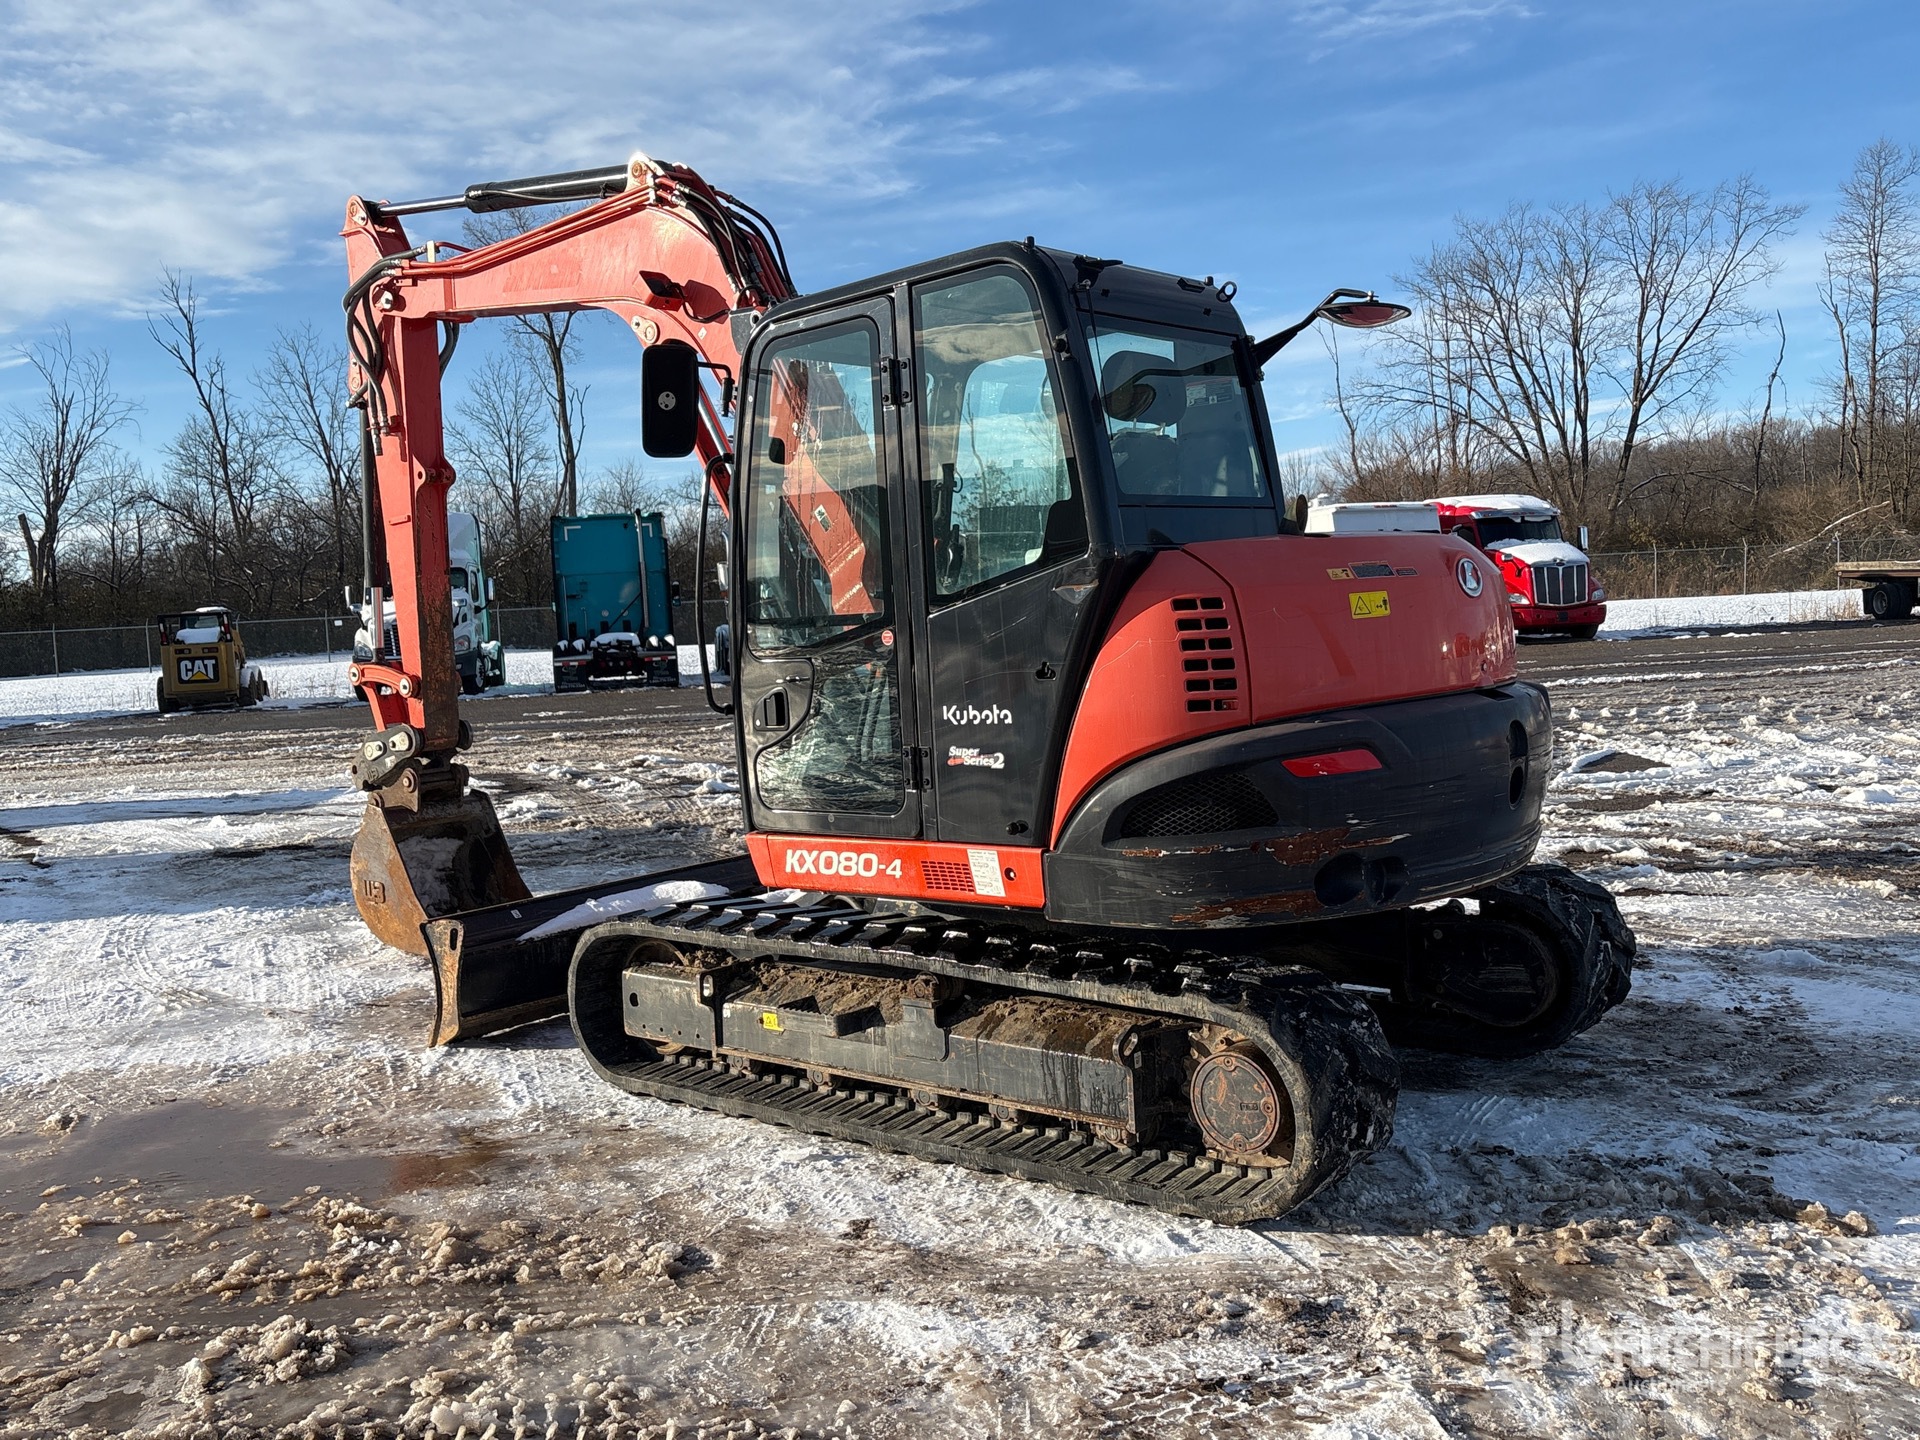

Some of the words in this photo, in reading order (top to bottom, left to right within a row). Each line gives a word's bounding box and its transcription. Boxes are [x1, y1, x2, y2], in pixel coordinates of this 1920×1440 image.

[180, 659, 216, 681] CAT
[942, 704, 1013, 725] Kubota
[948, 745, 981, 759] Super
[785, 848, 903, 879] KX080-4
